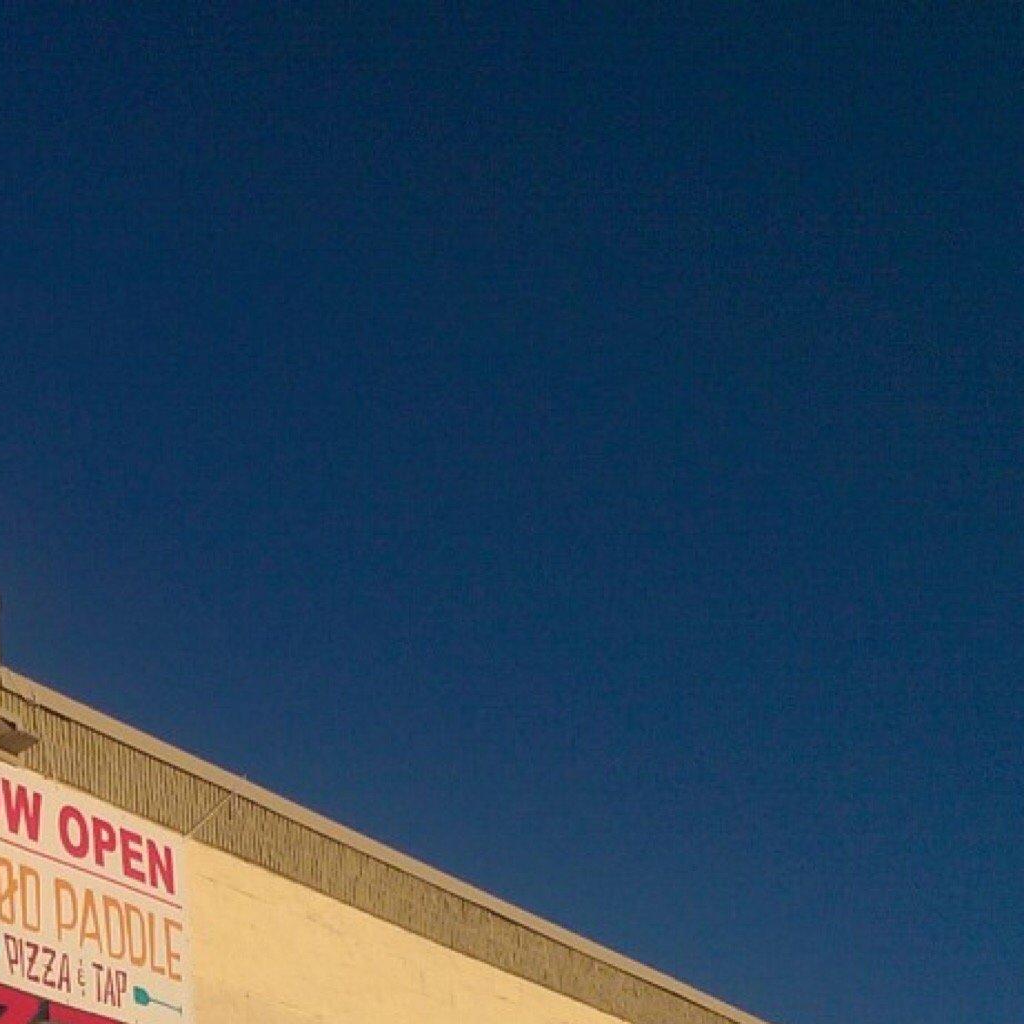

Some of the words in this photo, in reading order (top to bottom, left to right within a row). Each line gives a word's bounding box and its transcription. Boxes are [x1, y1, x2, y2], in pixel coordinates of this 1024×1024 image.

[59, 805, 176, 895] OPEN
[3, 932, 72, 994] PIZZA
[78, 958, 87, 996] &
[91, 962, 128, 1009] TAP
[55, 877, 183, 982] PADDLE
